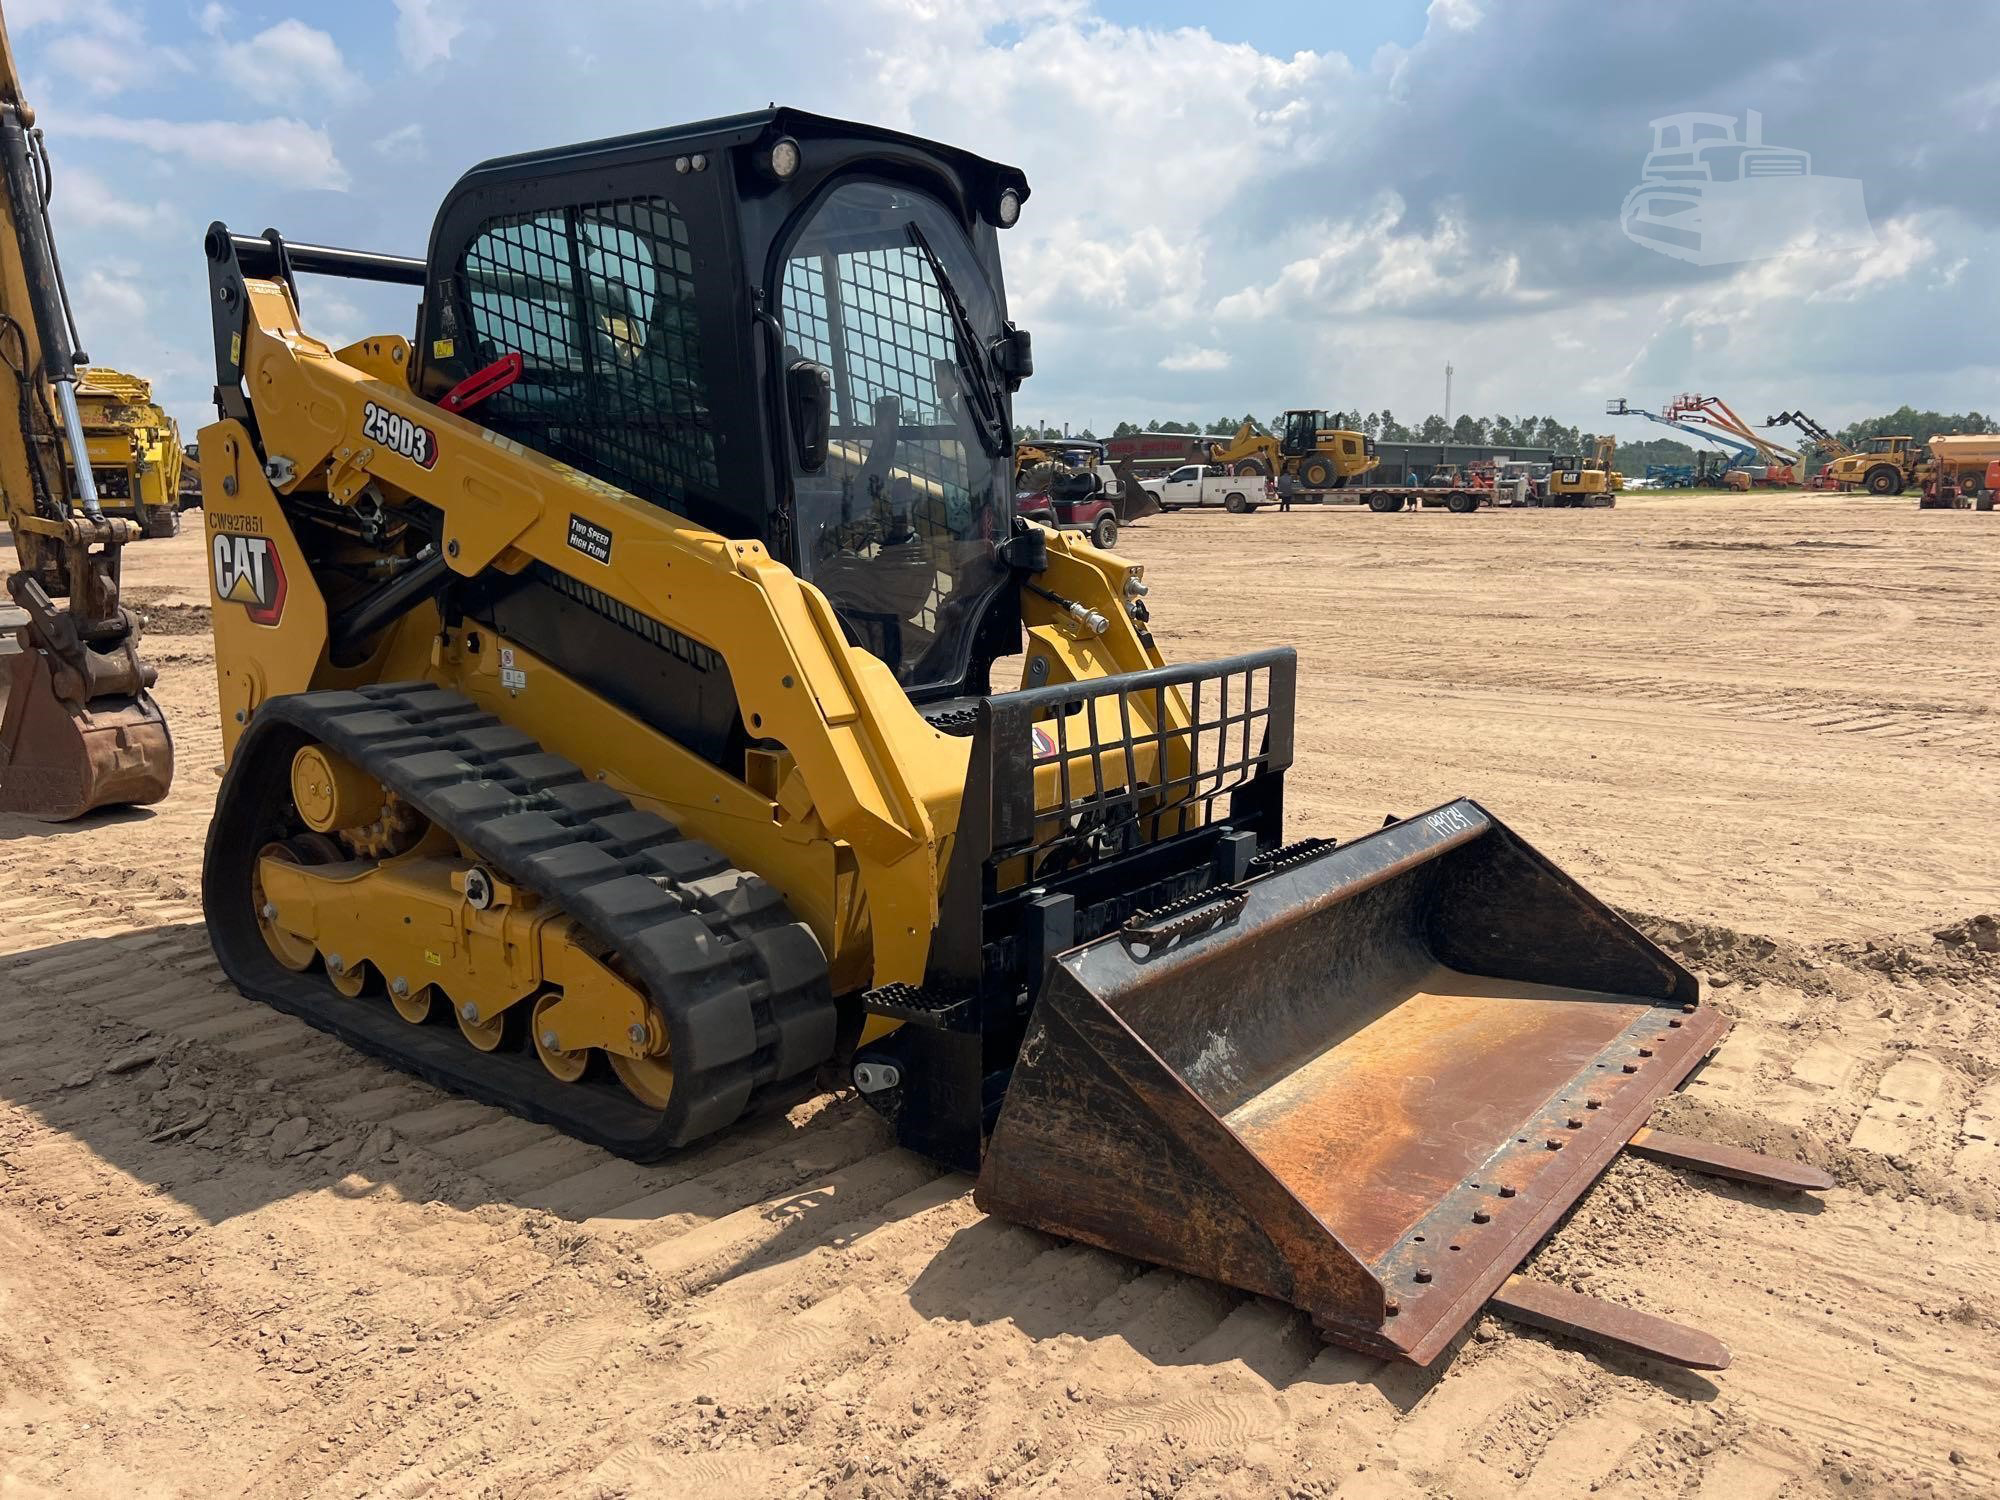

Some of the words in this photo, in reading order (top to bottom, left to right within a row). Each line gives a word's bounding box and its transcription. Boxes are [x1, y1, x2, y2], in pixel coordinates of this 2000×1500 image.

[364, 402, 427, 463] 259D3
[1563, 473, 1577, 483] CAT
[209, 512, 263, 533] CW927851
[213, 534, 267, 604] CAT
[1424, 806, 1474, 837] 199234
